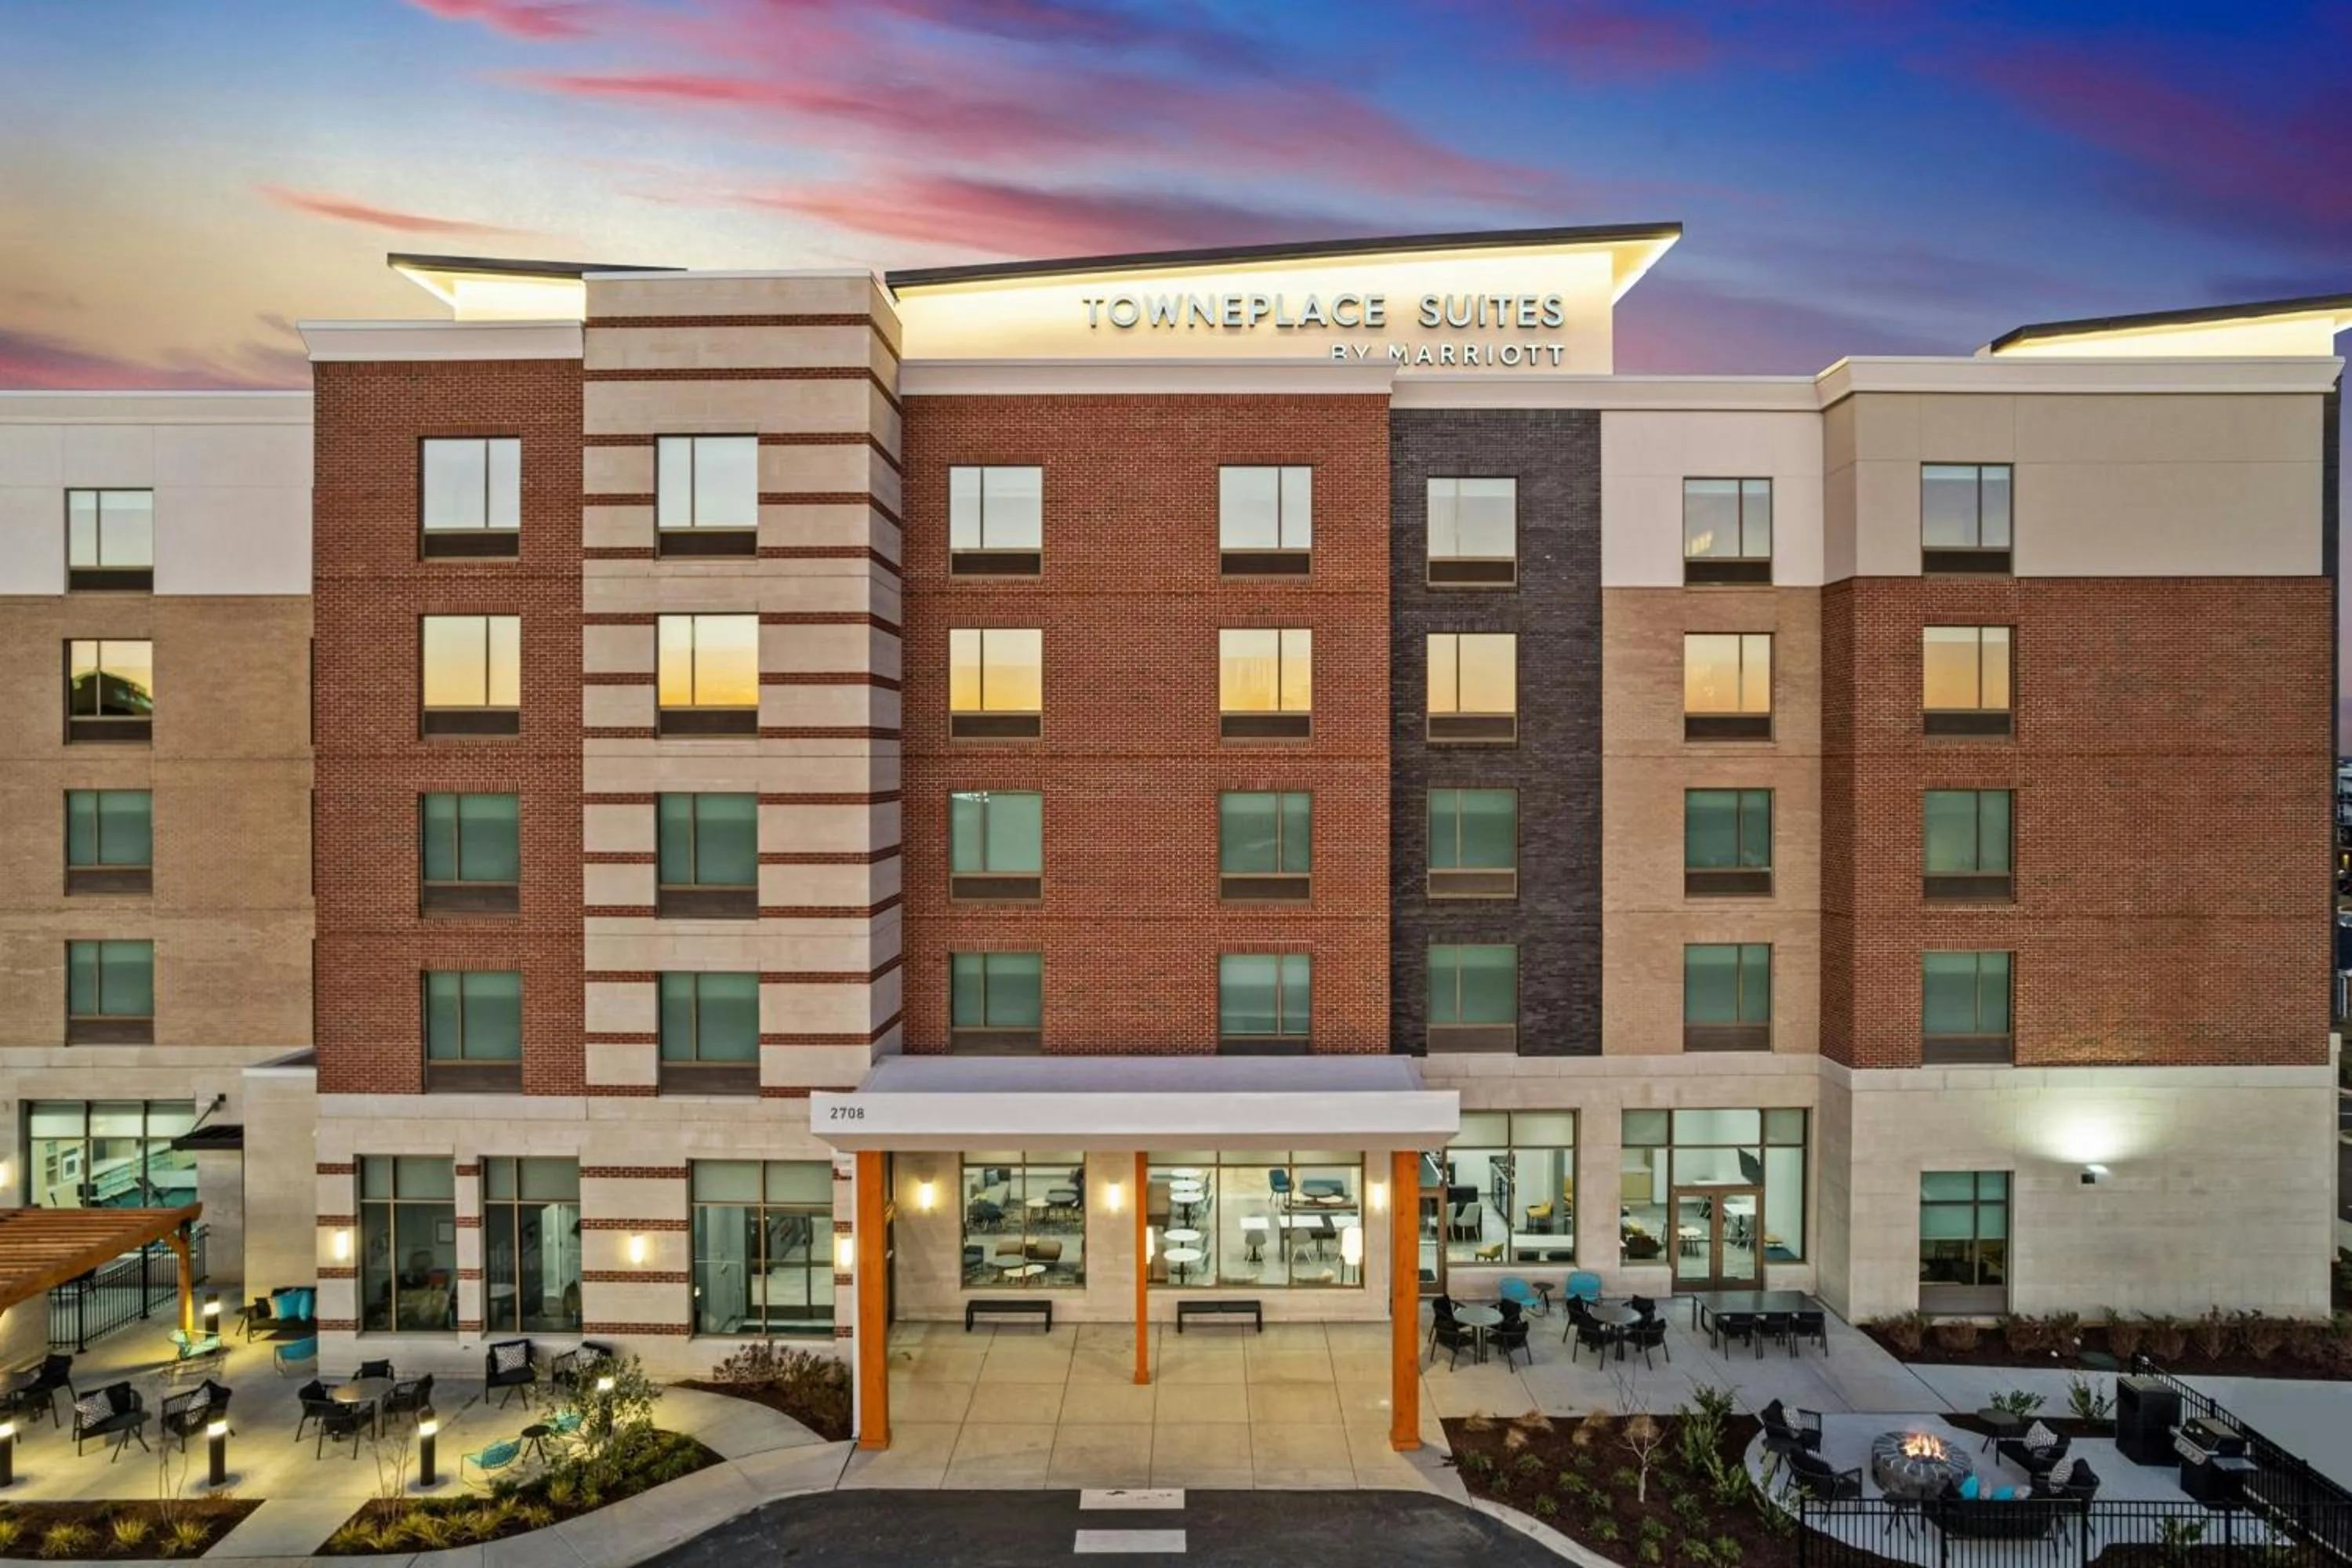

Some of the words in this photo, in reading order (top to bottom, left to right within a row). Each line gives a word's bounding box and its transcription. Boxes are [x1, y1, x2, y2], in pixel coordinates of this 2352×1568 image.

[1083, 293, 1385, 328] TOWNEPLACE
[1417, 294, 1565, 328] SUITES
[1330, 343, 1370, 359] BY
[1387, 343, 1566, 367] MARRIOTT
[829, 1106, 866, 1120] 2708
